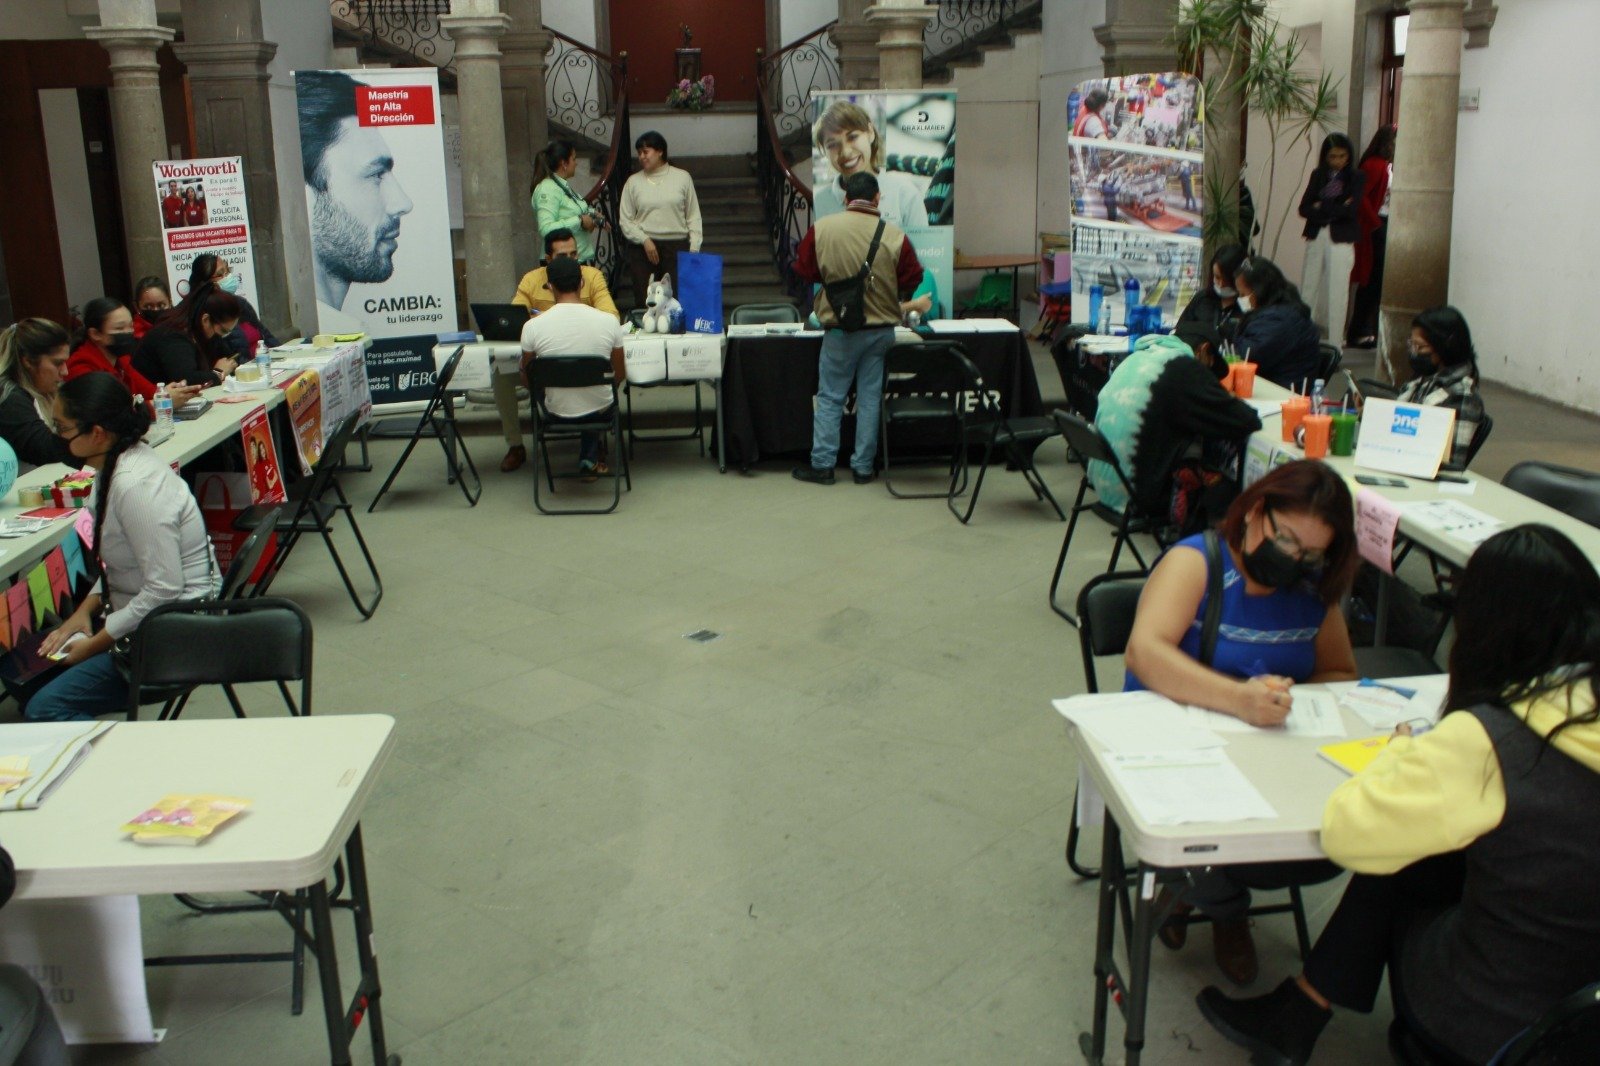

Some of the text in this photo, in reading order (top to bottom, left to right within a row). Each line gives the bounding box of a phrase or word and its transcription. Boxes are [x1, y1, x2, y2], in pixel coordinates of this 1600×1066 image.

[368, 90, 409, 100] Maestría
[383, 102, 401, 110] Alta
[370, 113, 414, 123] Dirección
[159, 161, 237, 178] Woolworth
[212, 206, 241, 215] SOLICITA
[210, 216, 245, 224] PERSONAL
[171, 253, 192, 262] INICIA
[364, 294, 442, 314] CAMBIA:
[387, 313, 443, 324] tu liderazgo
[411, 371, 438, 387] EBC
[370, 382, 391, 390] ados
